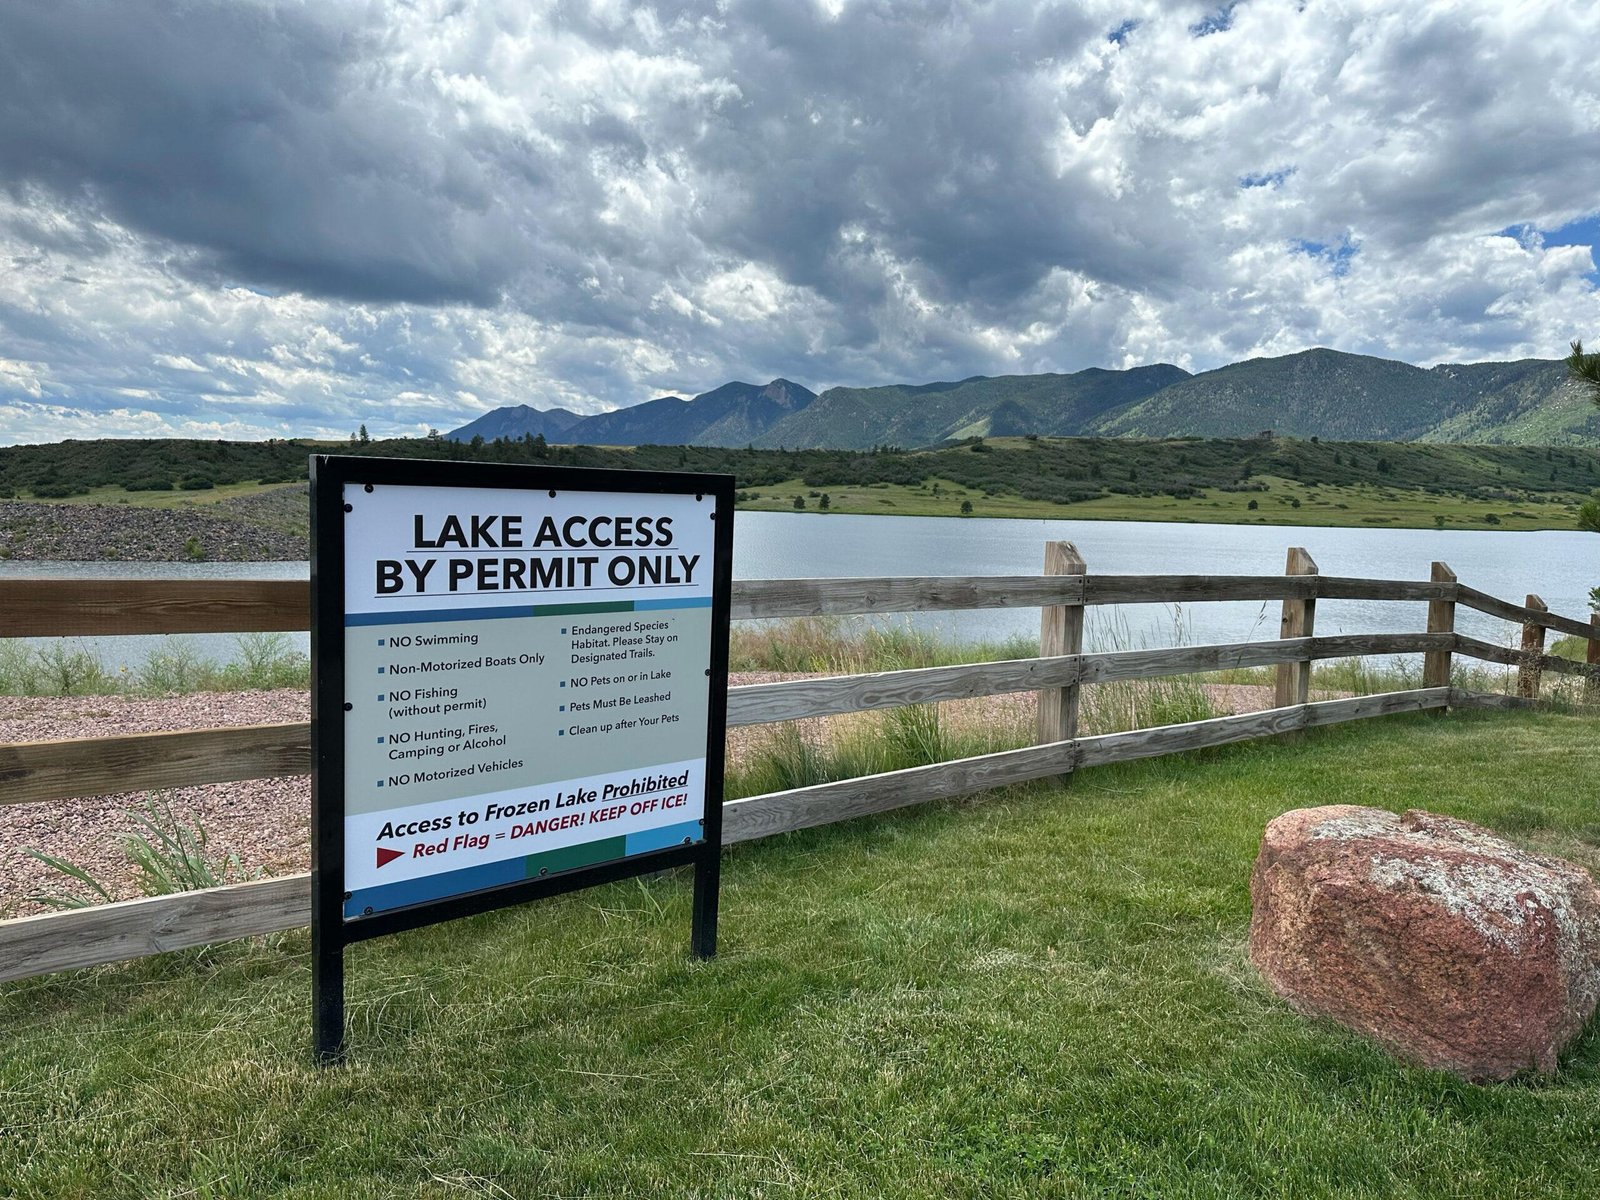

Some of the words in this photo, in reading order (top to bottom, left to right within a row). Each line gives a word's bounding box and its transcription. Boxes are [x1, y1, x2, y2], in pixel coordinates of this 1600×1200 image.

[415, 515, 523, 548] LAKE
[533, 516, 673, 547] ACCESS
[377, 559, 437, 594] BY
[449, 557, 599, 591] PERMIT
[608, 555, 700, 586] ONLY
[572, 622, 631, 636] Endangered
[634, 621, 669, 633] Species
[390, 636, 411, 648] NO
[415, 633, 478, 646] Swimming
[572, 639, 610, 649] Habitat.
[613, 636, 643, 646] Please
[645, 635, 665, 645] Stay
[390, 657, 481, 675] Non-Motorized
[486, 657, 516, 667] Boats
[519, 653, 545, 665] Only
[571, 650, 627, 664] Designated
[629, 648, 655, 658] Trails.
[571, 677, 588, 688] NO
[591, 676, 611, 686] Pets
[640, 672, 648, 680] in
[651, 669, 671, 679] Lake
[390, 690, 411, 702] NO
[415, 687, 457, 699] Fishing
[570, 702, 590, 712] Pets
[593, 699, 616, 709] Must
[619, 697, 631, 706] Be
[634, 691, 671, 704] Leashed
[389, 704, 441, 719] (without
[443, 698, 487, 715] permit)
[389, 733, 410, 744] NO
[415, 728, 465, 741] Hunting,
[469, 724, 498, 734] Fires,
[569, 725, 597, 735] Clean
[600, 724, 613, 733] up
[615, 719, 637, 729] after
[639, 717, 659, 726] Your
[661, 714, 679, 723] Pets
[389, 745, 444, 760] Camping
[448, 744, 460, 752] or
[462, 735, 506, 750] Alcohol
[389, 775, 410, 787] NO
[414, 766, 474, 783] Motorized
[478, 759, 523, 773] Vehicles
[376, 816, 452, 841] Access
[458, 811, 479, 826] to
[485, 799, 550, 821] Frozen
[556, 788, 597, 808] Lake
[602, 770, 689, 801] Prohibited
[413, 838, 449, 858] Red
[453, 834, 490, 850] Flag
[510, 813, 585, 839] DANGER!
[589, 805, 627, 824] KEEP
[630, 799, 659, 815] OFF
[661, 793, 688, 810] ICE!
